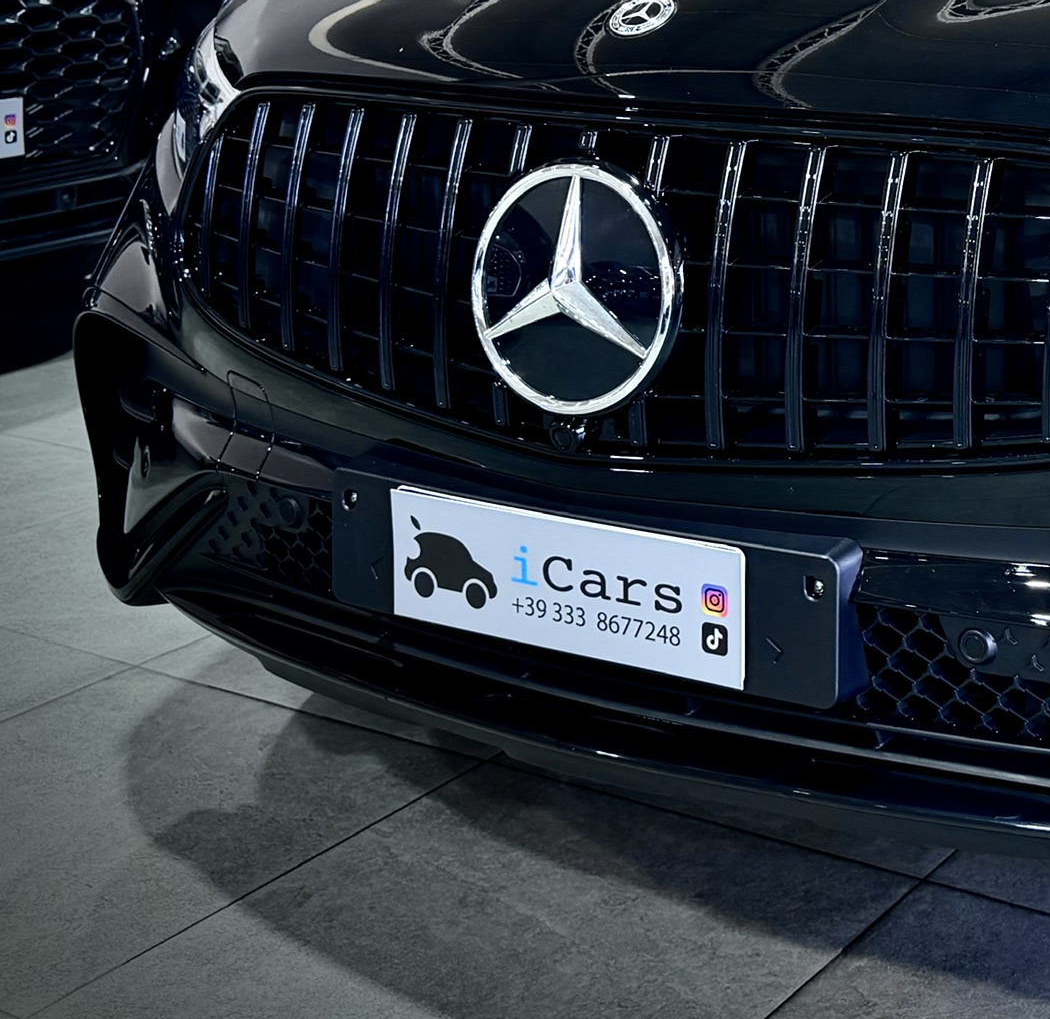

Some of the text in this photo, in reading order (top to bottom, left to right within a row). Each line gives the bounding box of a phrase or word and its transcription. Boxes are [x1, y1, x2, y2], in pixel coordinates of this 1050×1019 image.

[511, 545, 683, 614] iCars
[511, 596, 681, 647] +39 333 8677248
